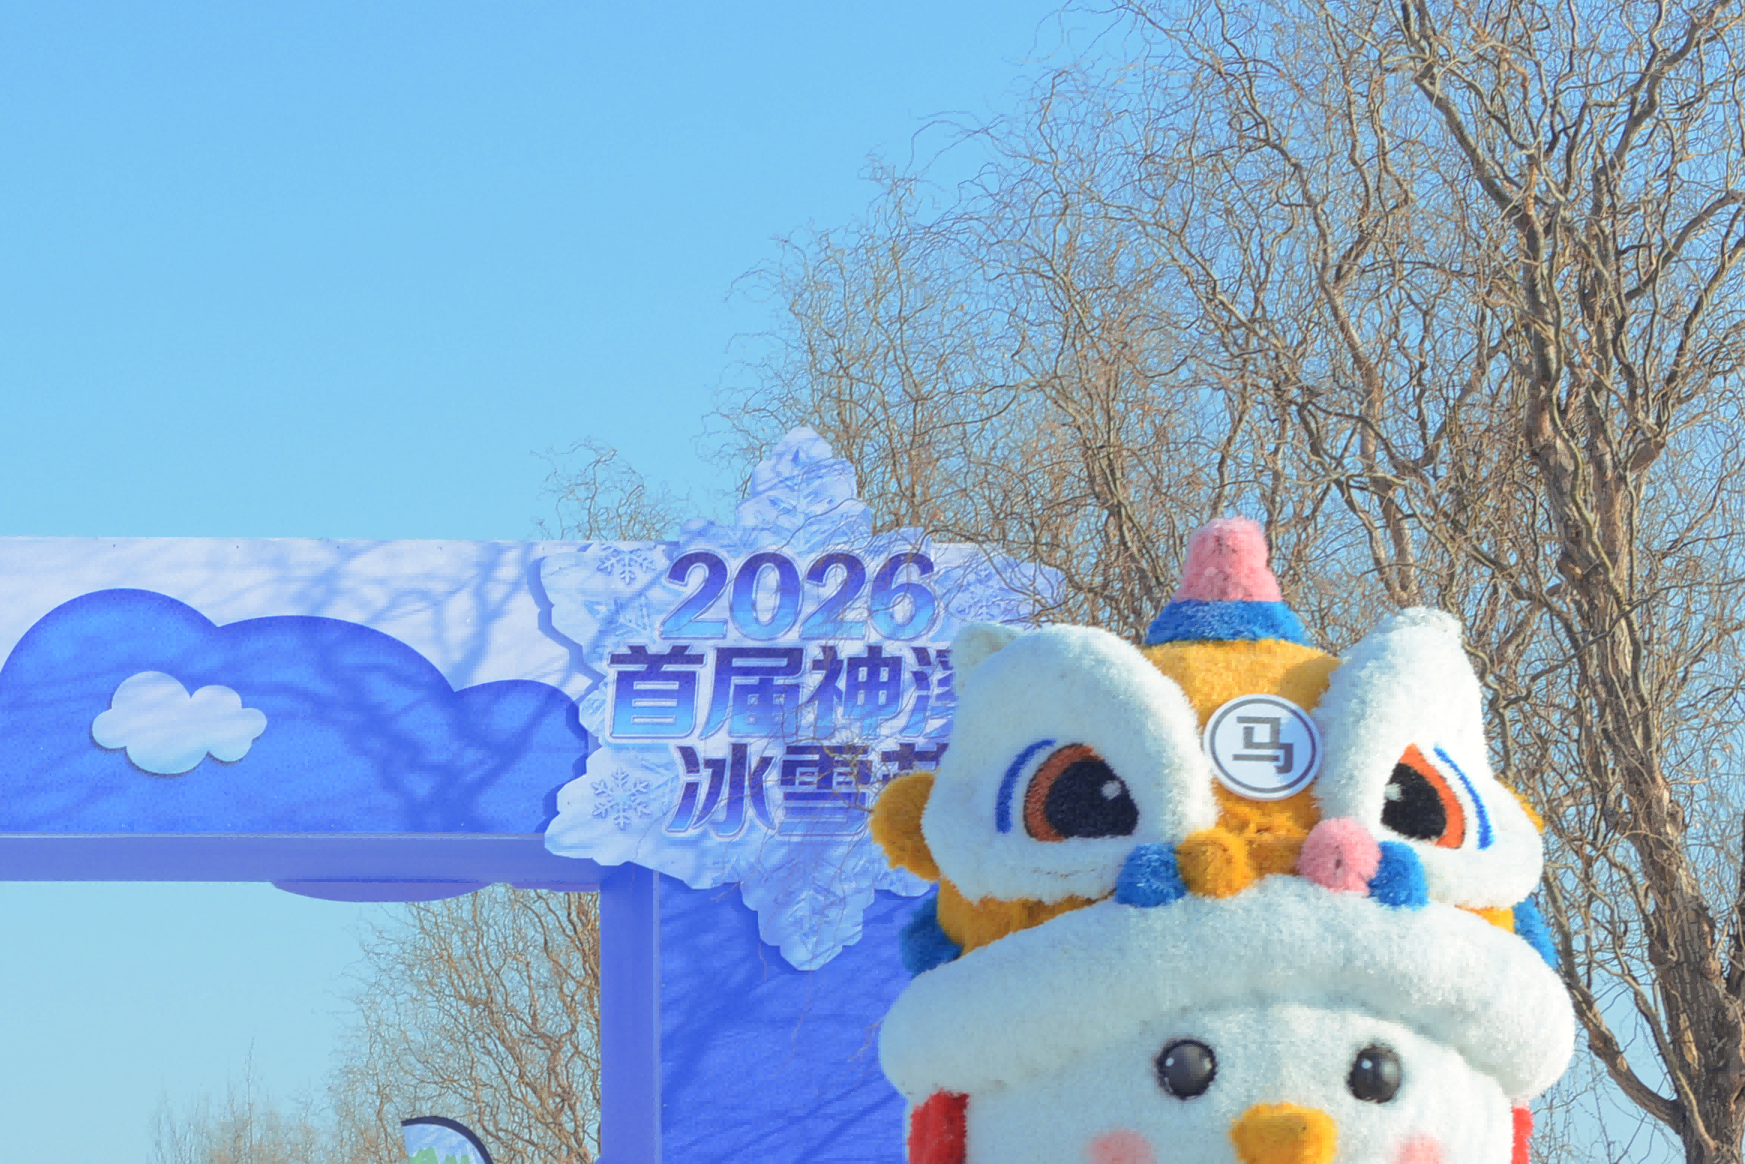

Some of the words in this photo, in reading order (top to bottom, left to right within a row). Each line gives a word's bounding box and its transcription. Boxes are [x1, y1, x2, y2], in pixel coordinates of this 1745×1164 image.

[657, 551, 937, 640] 2026
[1232, 716, 1294, 774] 马
[664, 743, 950, 838] 冰雪
